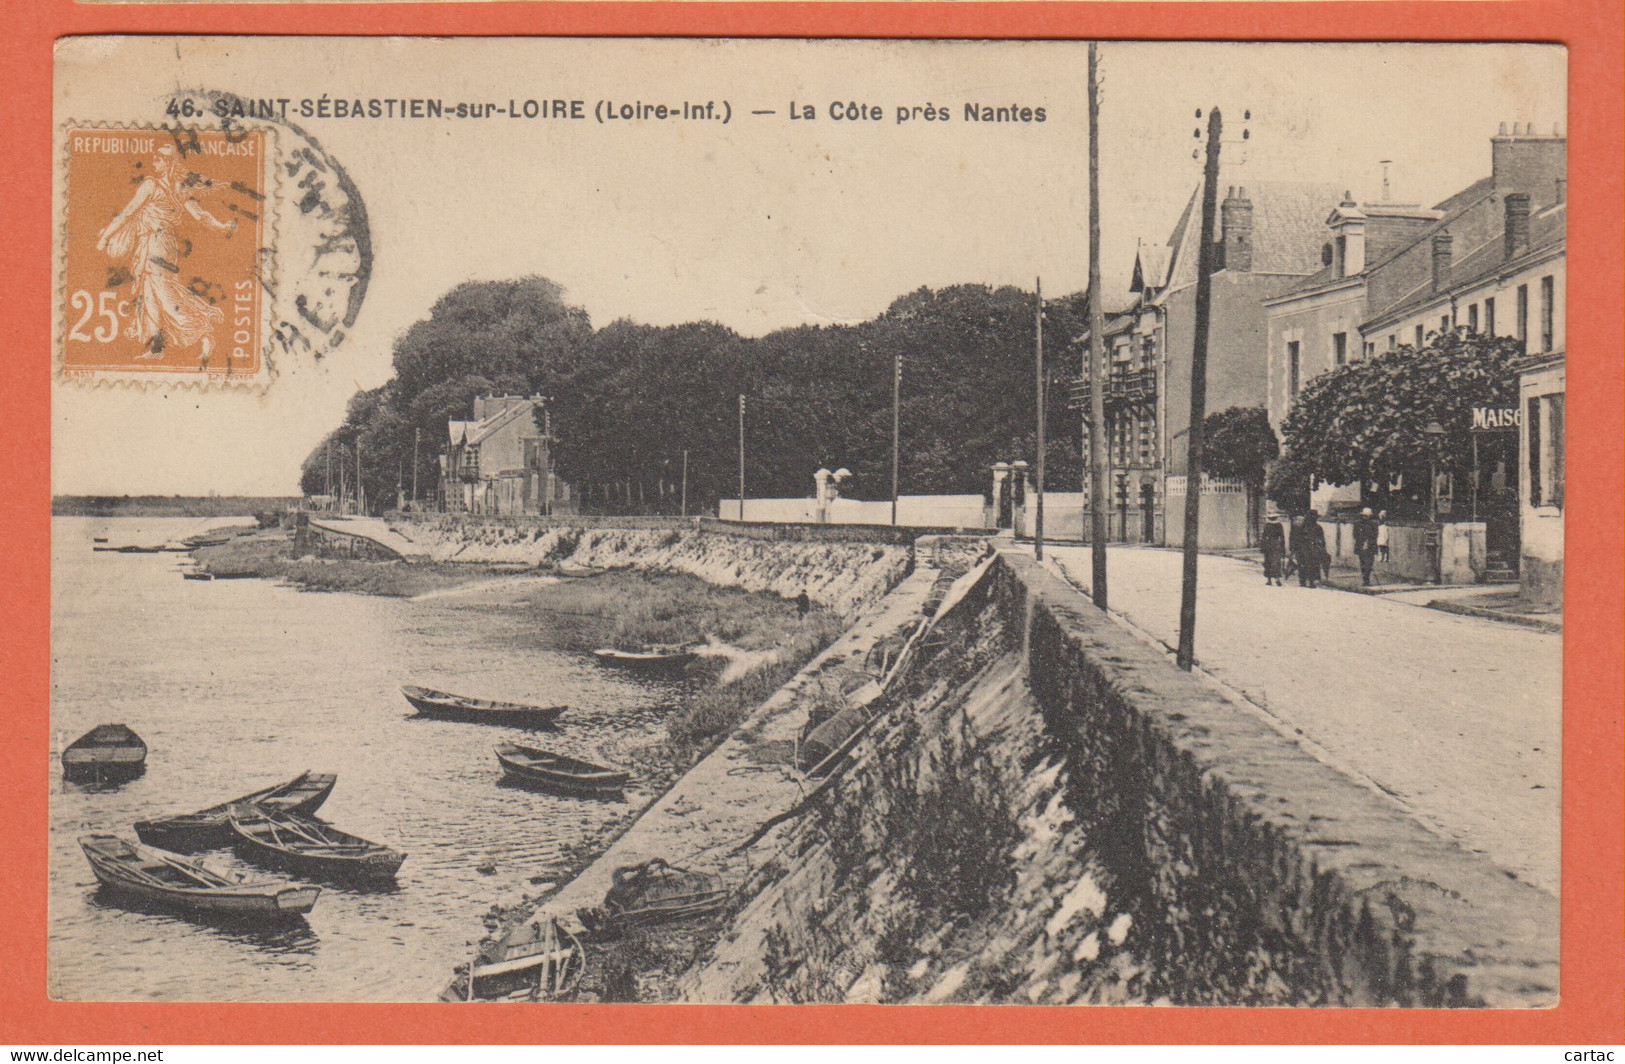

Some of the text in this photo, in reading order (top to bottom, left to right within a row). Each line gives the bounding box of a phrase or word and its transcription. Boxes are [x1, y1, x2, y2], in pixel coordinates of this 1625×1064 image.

[165, 98, 204, 118] 46.
[595, 100, 733, 122] (Loire-Inf.)
[789, 101, 815, 119] La
[828, 100, 883, 120] Côte
[897, 103, 950, 123] près
[964, 102, 1047, 122] Nantes
[233, 280, 252, 358] POSTES
